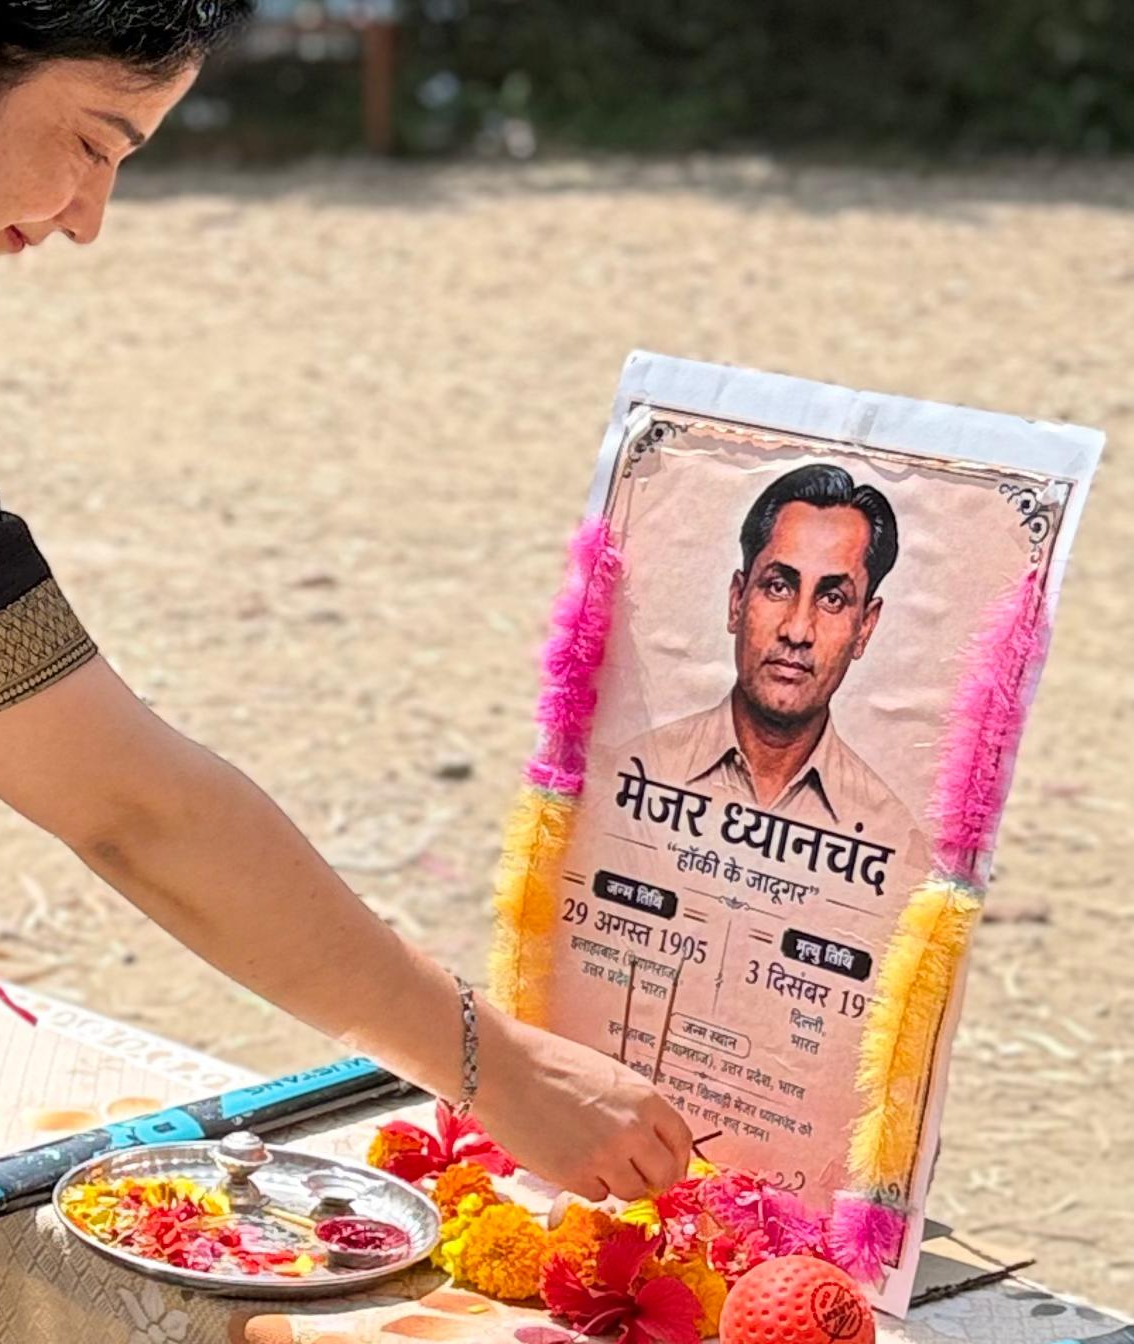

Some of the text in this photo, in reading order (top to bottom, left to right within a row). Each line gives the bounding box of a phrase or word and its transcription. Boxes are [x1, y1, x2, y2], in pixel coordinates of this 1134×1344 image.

[616, 756, 896, 897] मेजर ध्यानचंद
[723, 858, 744, 885] के
[605, 878, 666, 912] जन्म तिथि
[562, 898, 709, 965] 29 अगस्त 1905
[795, 938, 855, 971] मृत्यु तिथि
[640, 980, 668, 1000] भारत
[745, 959, 760, 985] 3
[766, 962, 832, 1008] दिसंबर
[682, 1020, 738, 1051] जन्म स्थान
[790, 1034, 821, 1055] भारत
[778, 1079, 806, 1101] भारत
[687, 1102, 700, 1117] पर
[797, 1121, 813, 1138] को
